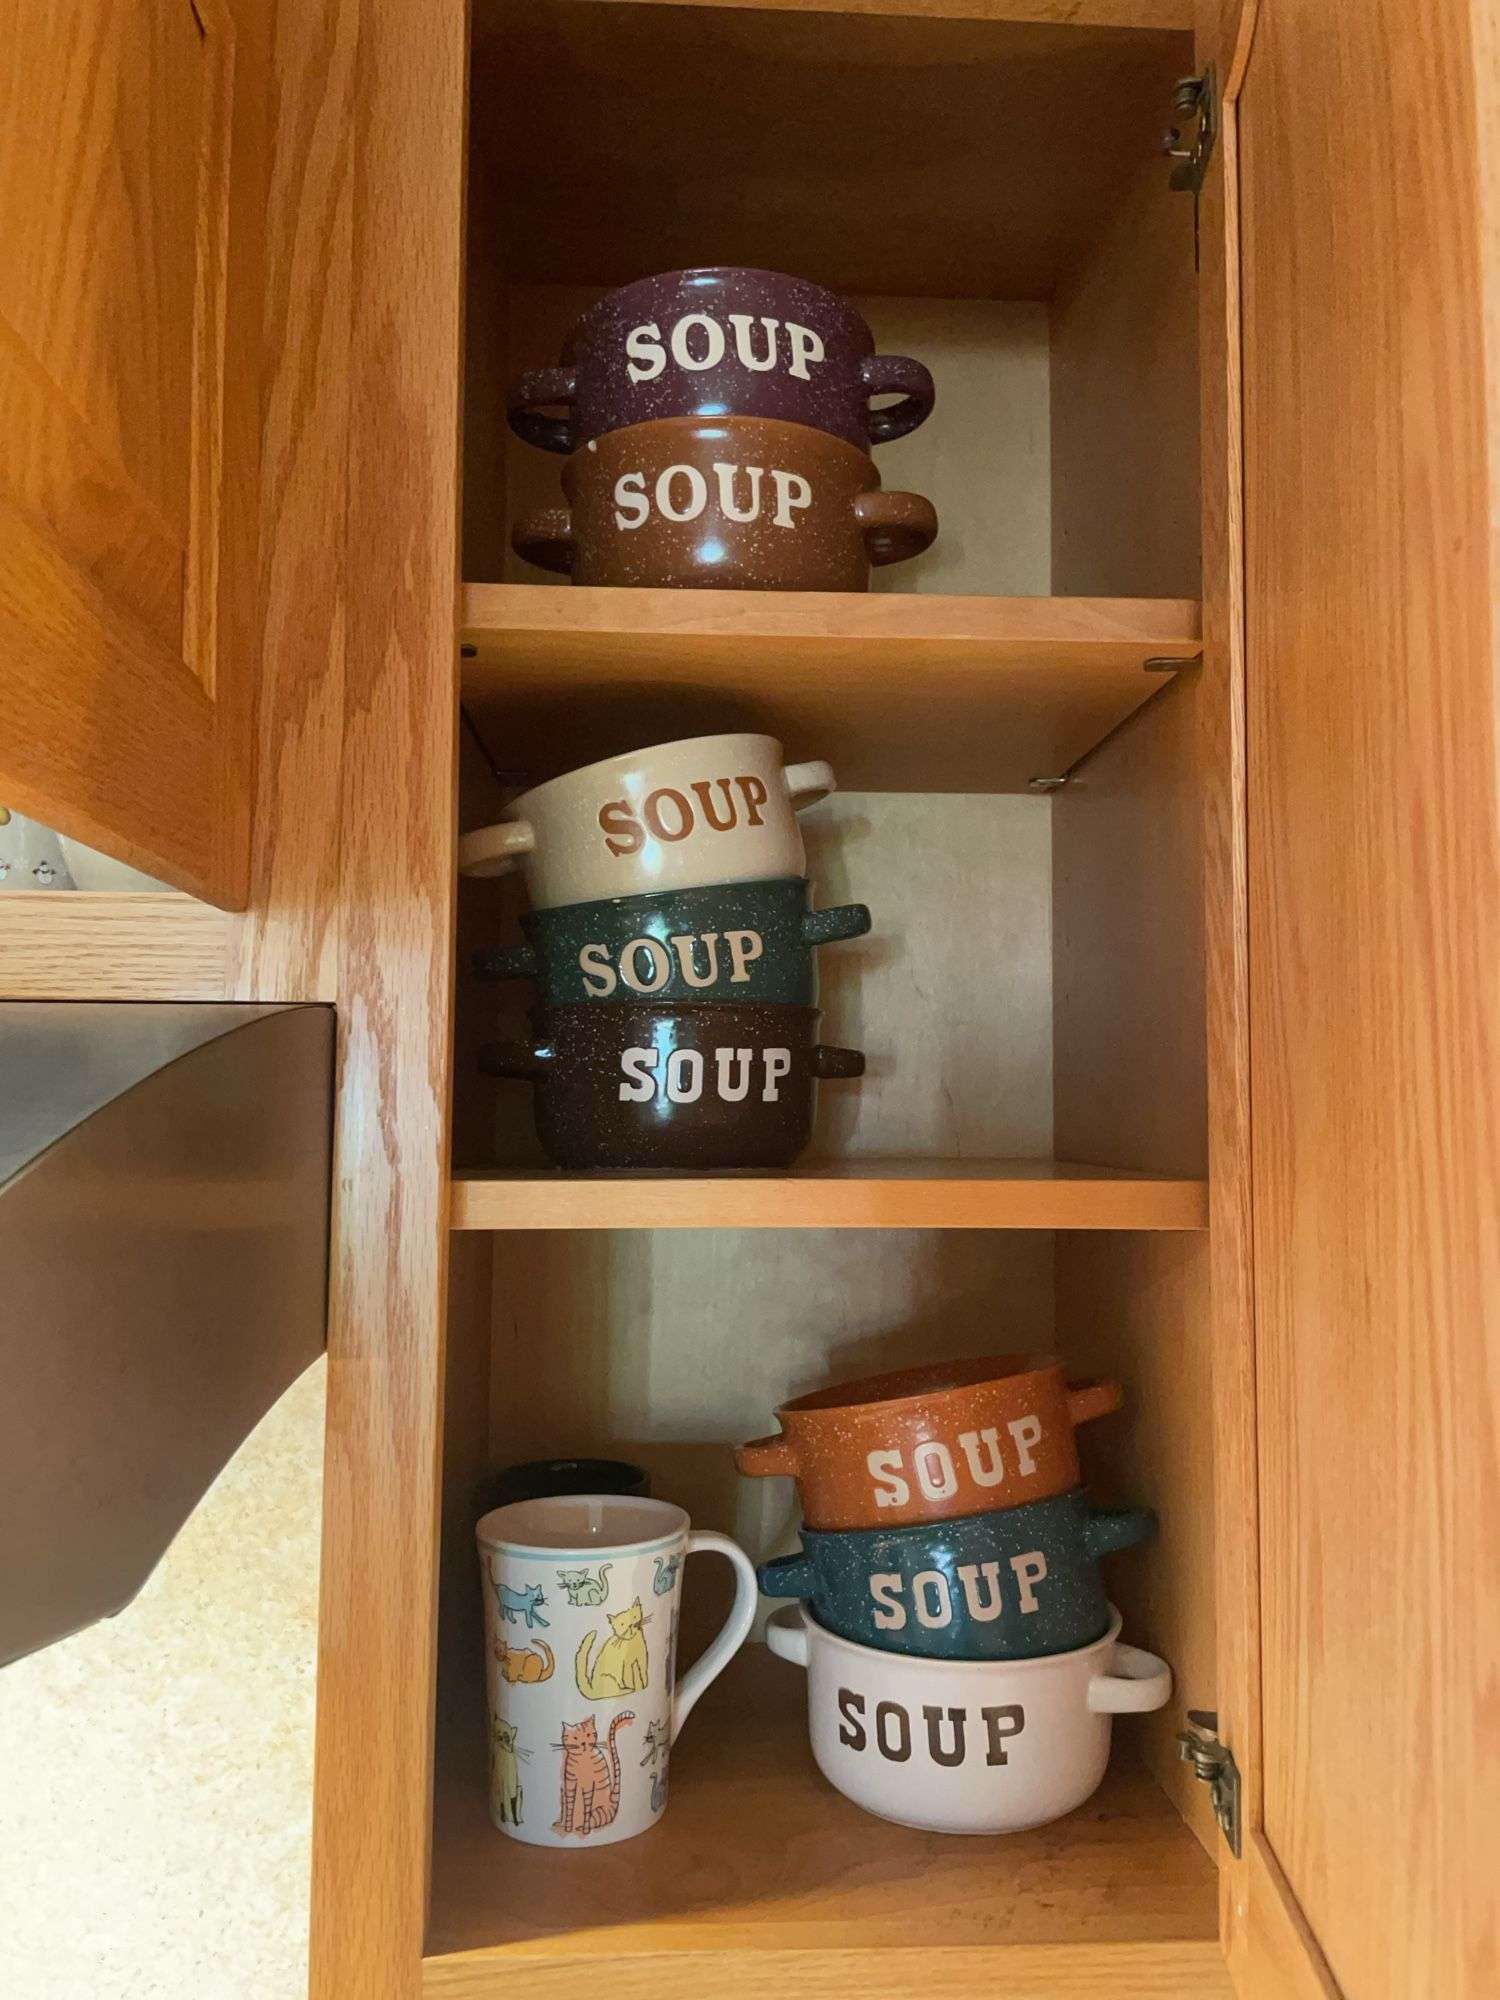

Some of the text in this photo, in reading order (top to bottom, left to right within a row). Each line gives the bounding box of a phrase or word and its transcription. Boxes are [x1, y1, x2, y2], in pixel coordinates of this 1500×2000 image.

[625, 312, 826, 384] SOUP
[614, 462, 812, 531] SOUP
[598, 775, 768, 858] SOUP
[578, 930, 763, 998] SOUP
[619, 1047, 791, 1103] SOUP
[866, 1414, 1044, 1509] SOUP
[869, 1550, 1048, 1631] SOUP
[837, 1687, 1026, 1767] SOUP
